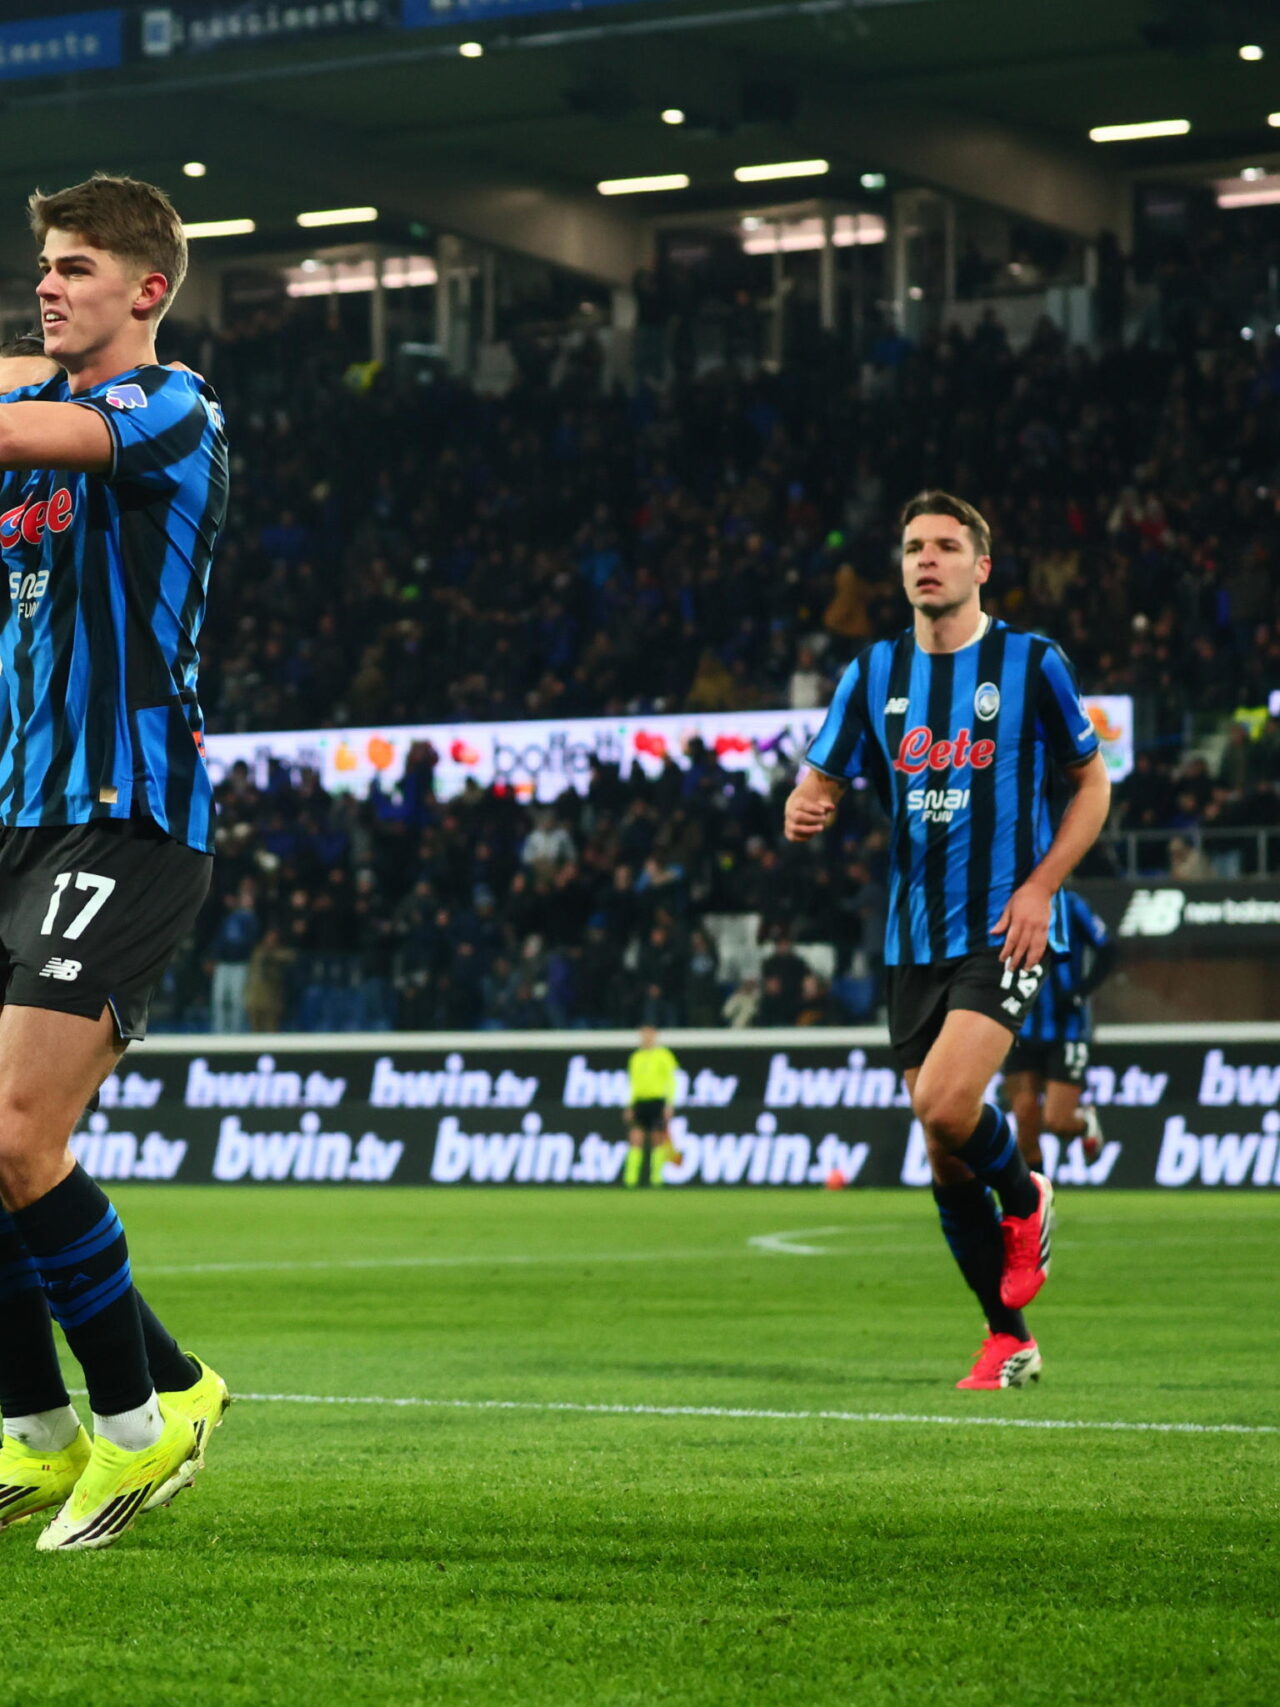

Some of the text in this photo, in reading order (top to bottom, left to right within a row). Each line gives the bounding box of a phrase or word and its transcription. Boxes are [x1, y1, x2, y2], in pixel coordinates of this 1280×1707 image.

[892, 726, 996, 775] Lete
[921, 810, 954, 823] FUN
[40, 871, 116, 940] 17
[185, 1054, 347, 1108] bwin.tv
[370, 1053, 539, 1108] bwin.tv
[764, 1050, 913, 1108] bwin.
[213, 1111, 405, 1182] bwin.tv
[430, 1112, 629, 1184] bwin.tv
